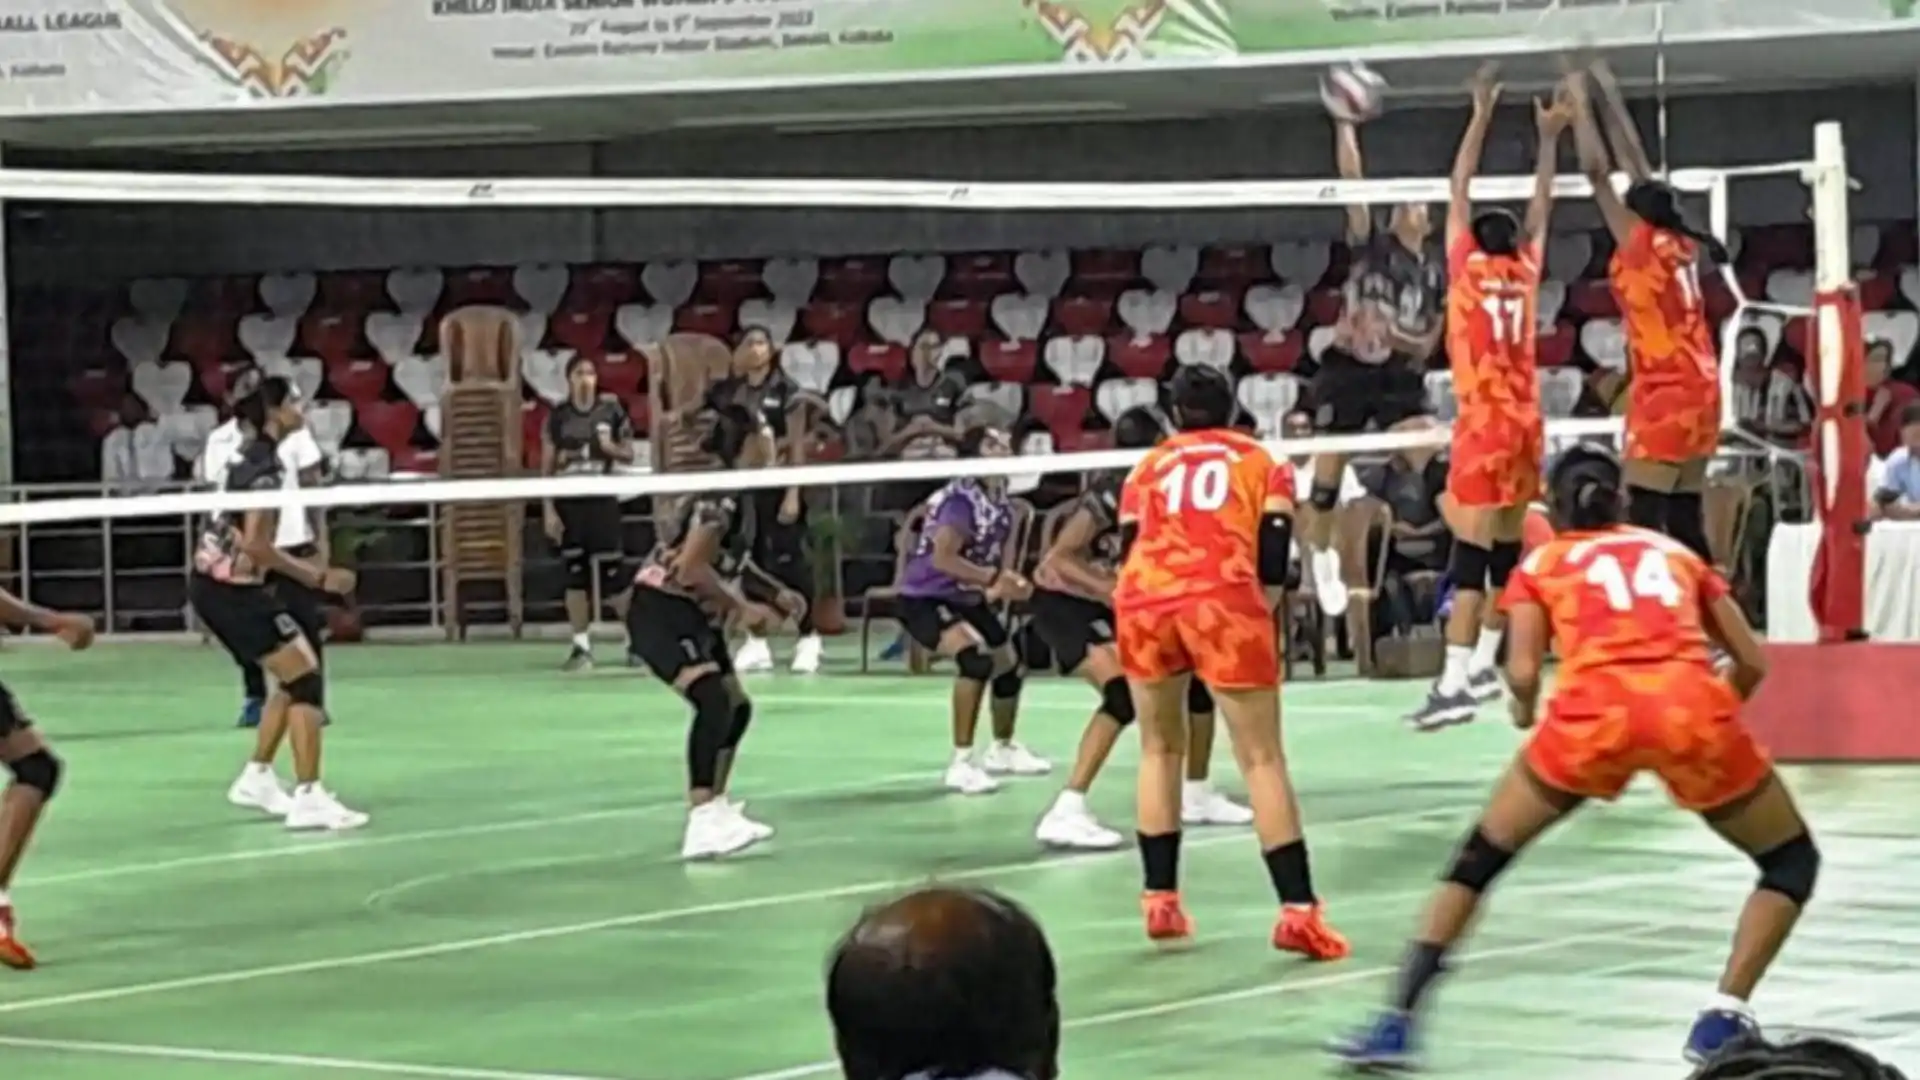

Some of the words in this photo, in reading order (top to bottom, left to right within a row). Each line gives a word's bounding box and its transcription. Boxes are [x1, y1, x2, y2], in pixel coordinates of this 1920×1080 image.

[0, 14, 39, 32] ALL
[1481, 293, 1524, 344] 17
[1159, 459, 1229, 515] 10
[1585, 548, 1682, 612] 14
